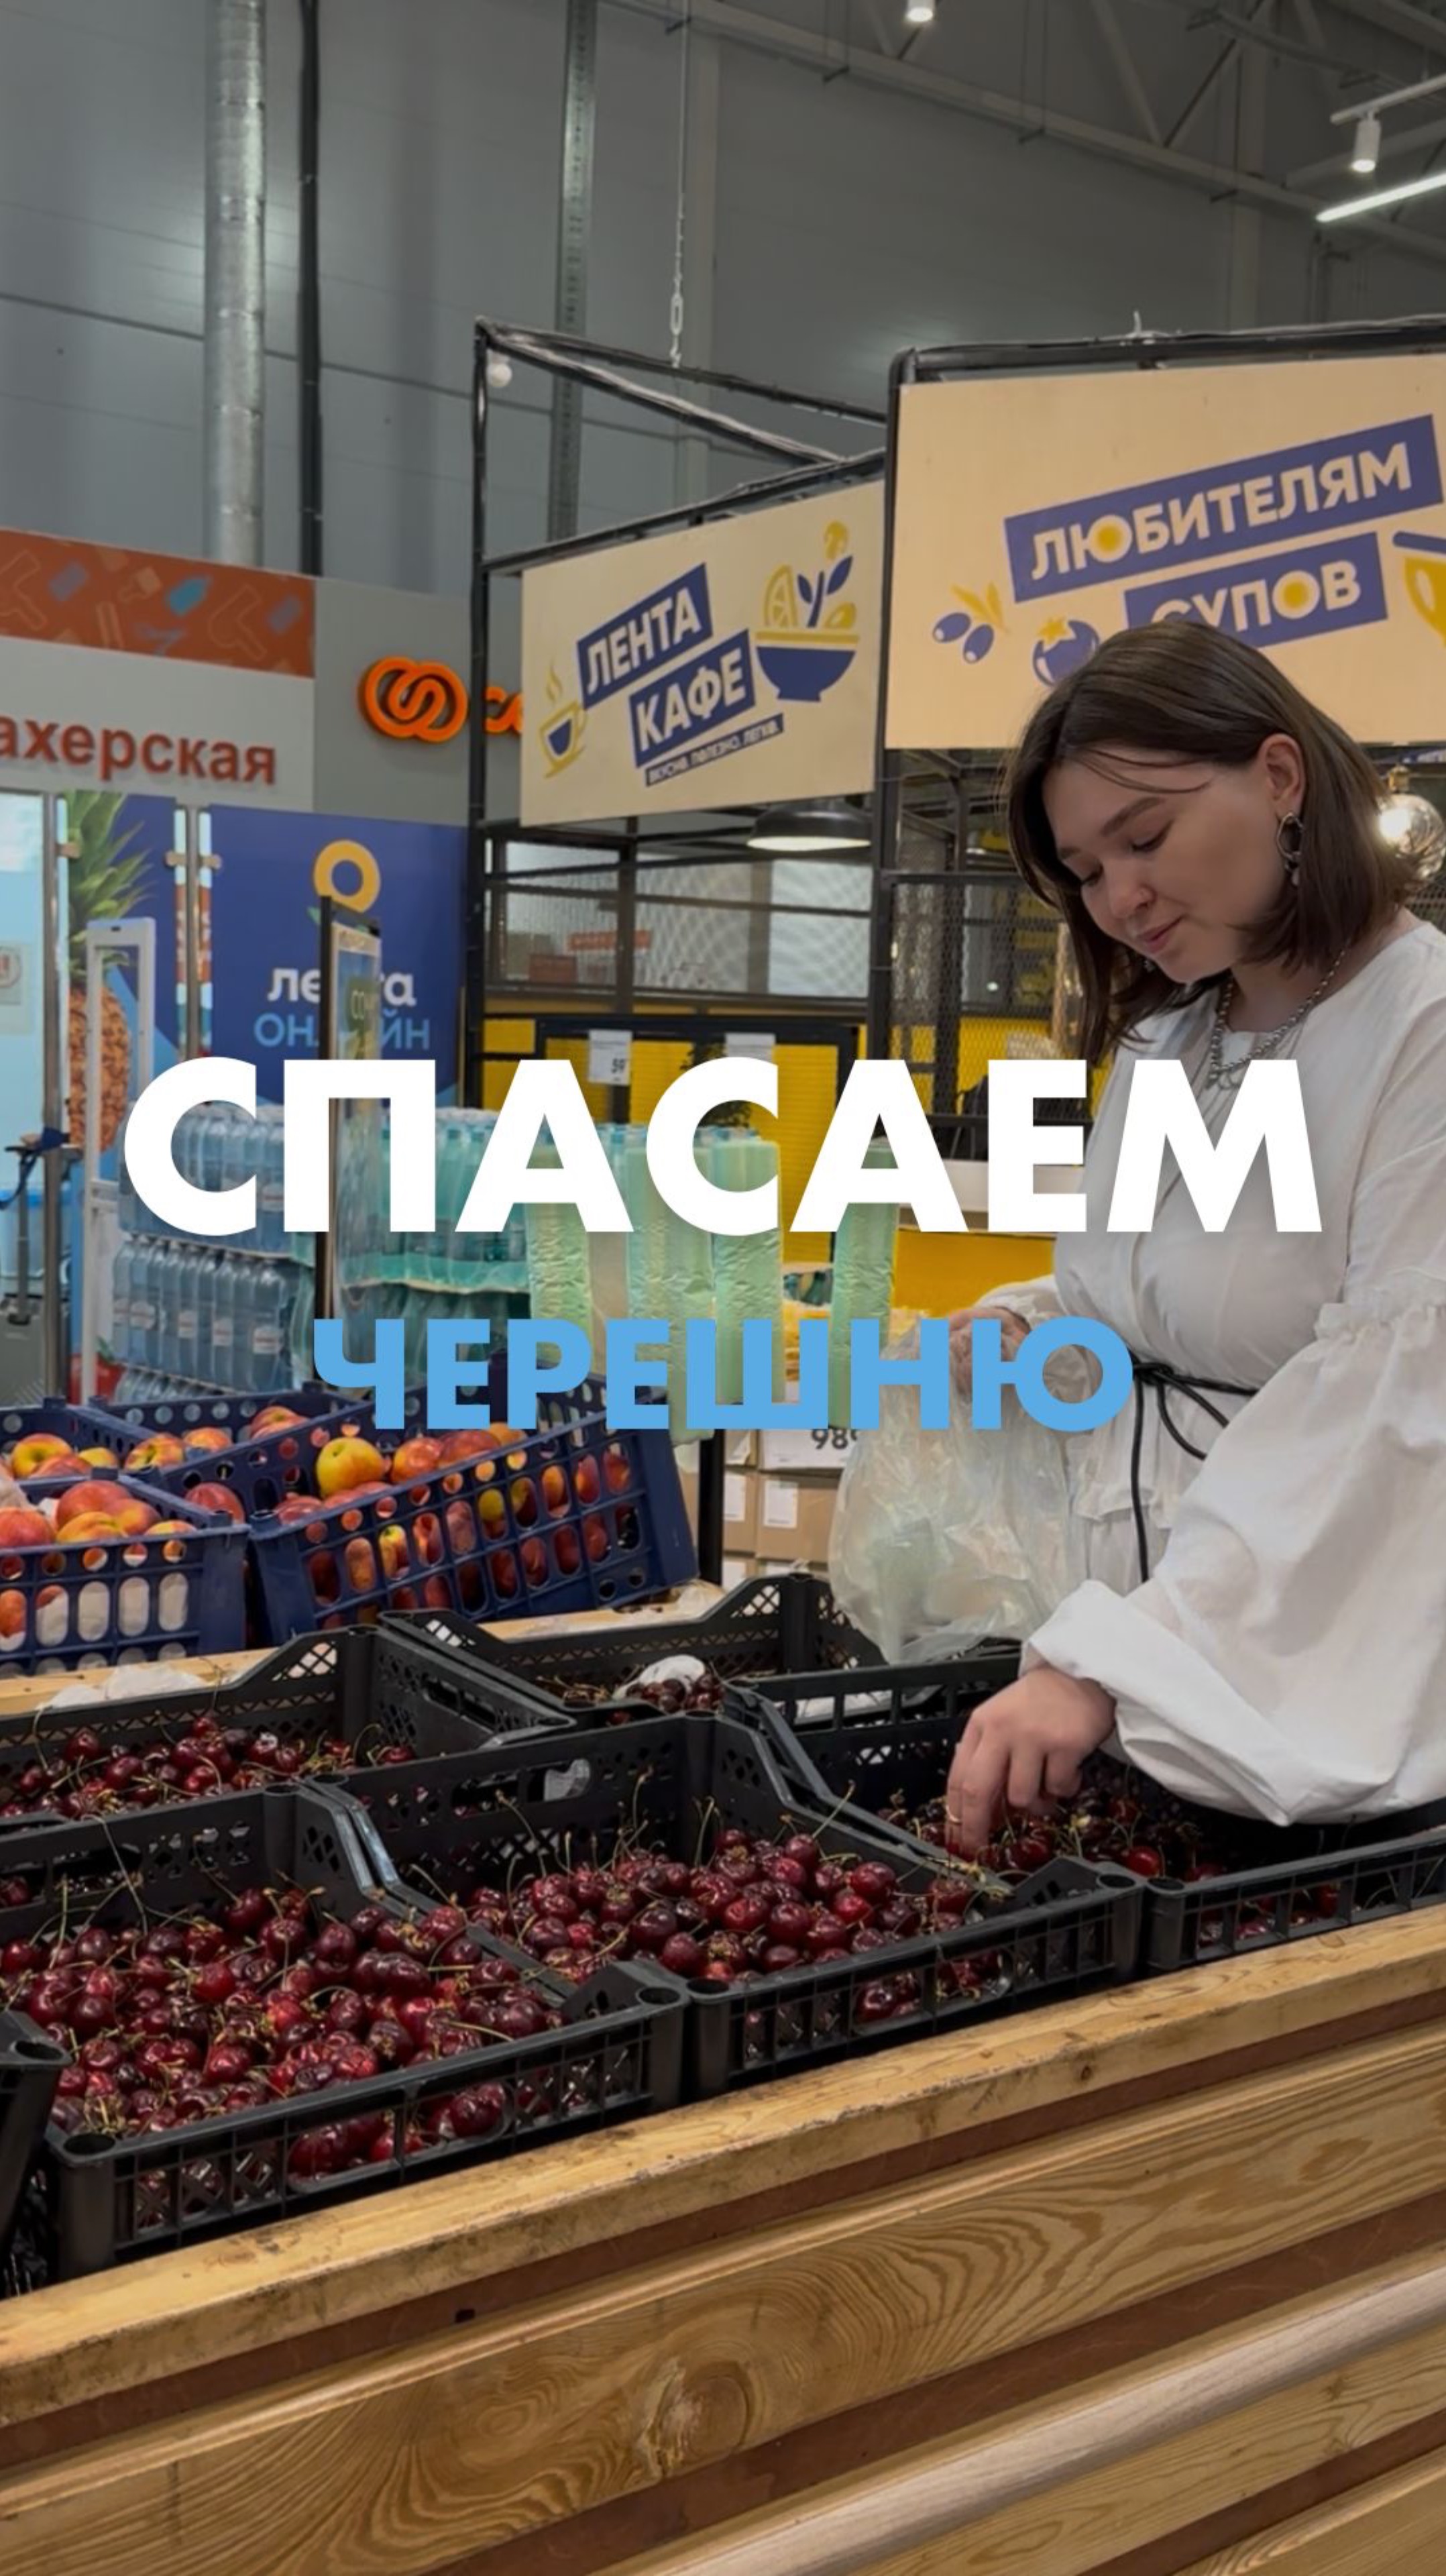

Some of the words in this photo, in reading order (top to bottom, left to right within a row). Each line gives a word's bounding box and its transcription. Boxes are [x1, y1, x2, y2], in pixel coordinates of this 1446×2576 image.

[1032, 442, 1411, 581] ЛЮБИТЕЛЯМ
[588, 586, 702, 695] ЛЕНТА
[636, 647, 746, 752] КАФЕ
[254, 1008, 429, 1049] ОНЙН
[267, 967, 416, 1006] леа
